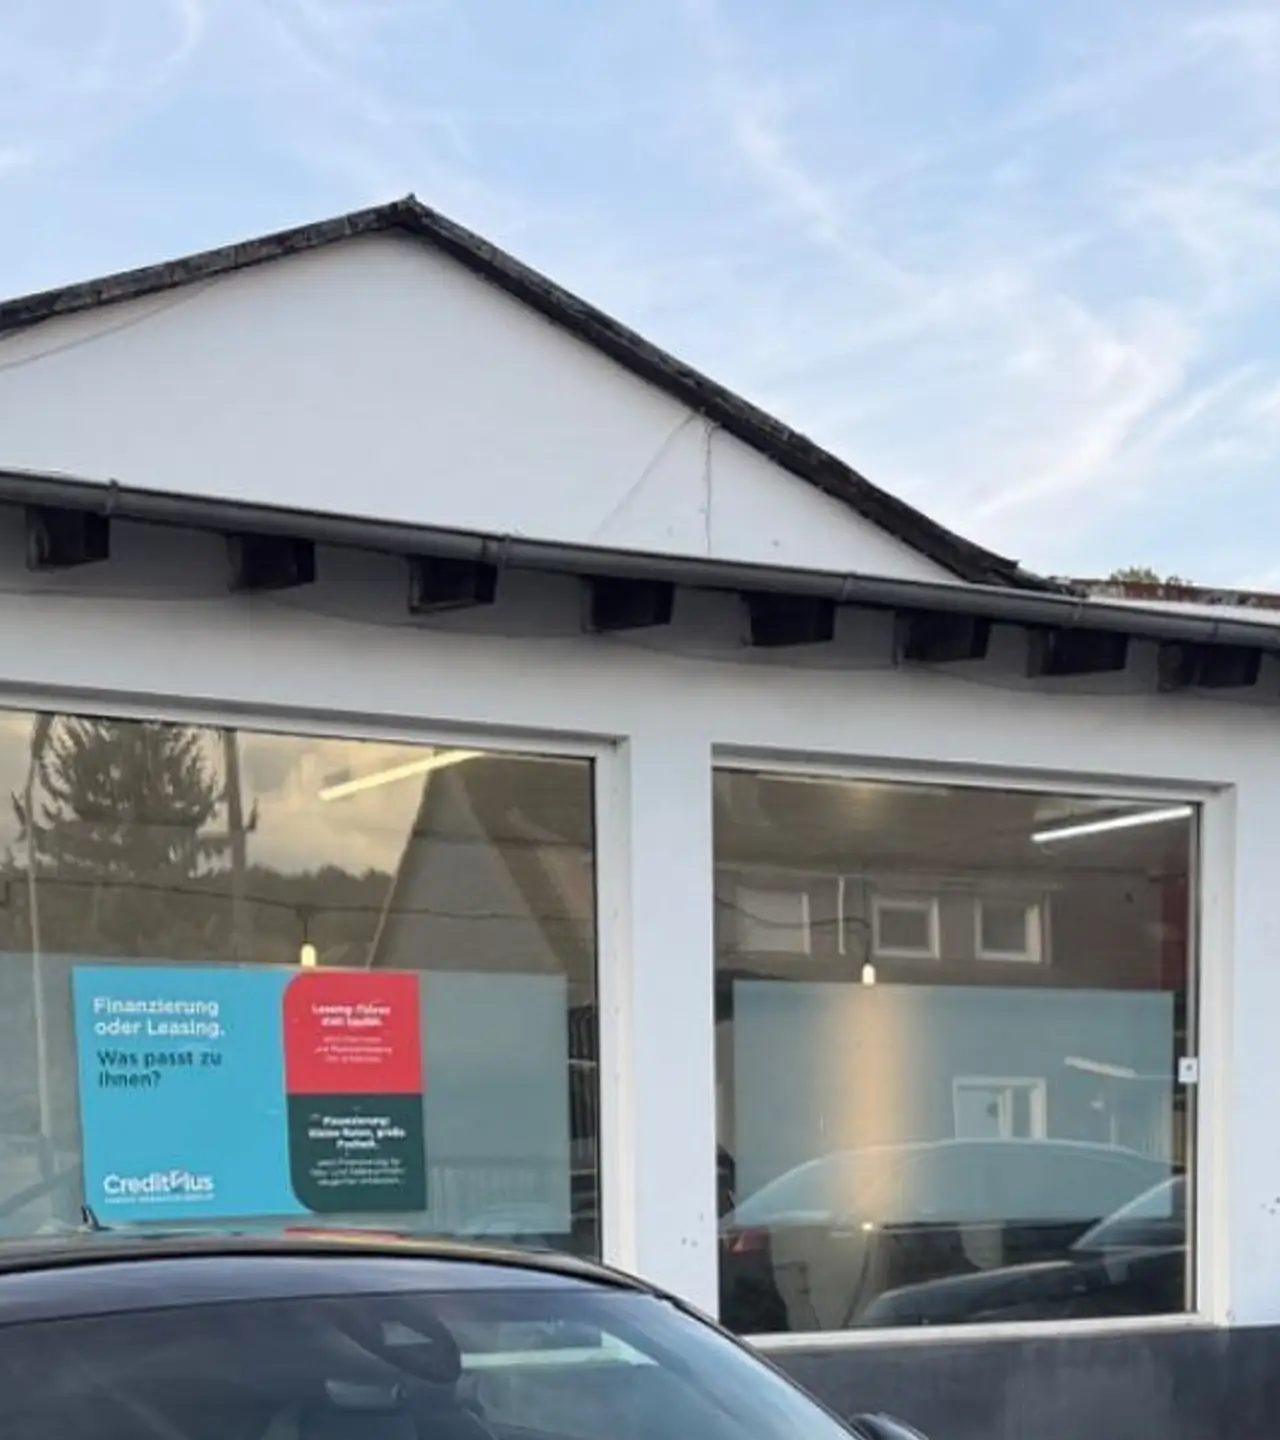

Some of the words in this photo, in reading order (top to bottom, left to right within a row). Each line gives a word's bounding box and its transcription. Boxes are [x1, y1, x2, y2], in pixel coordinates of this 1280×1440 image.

[93, 997, 219, 1018] Finanzierung
[95, 1018, 141, 1036] oder
[147, 1018, 226, 1039] Leasing.
[96, 1049, 138, 1068] Was
[143, 1050, 193, 1069] passt
[200, 1052, 223, 1068] zu
[99, 1070, 162, 1089] Ihnen?
